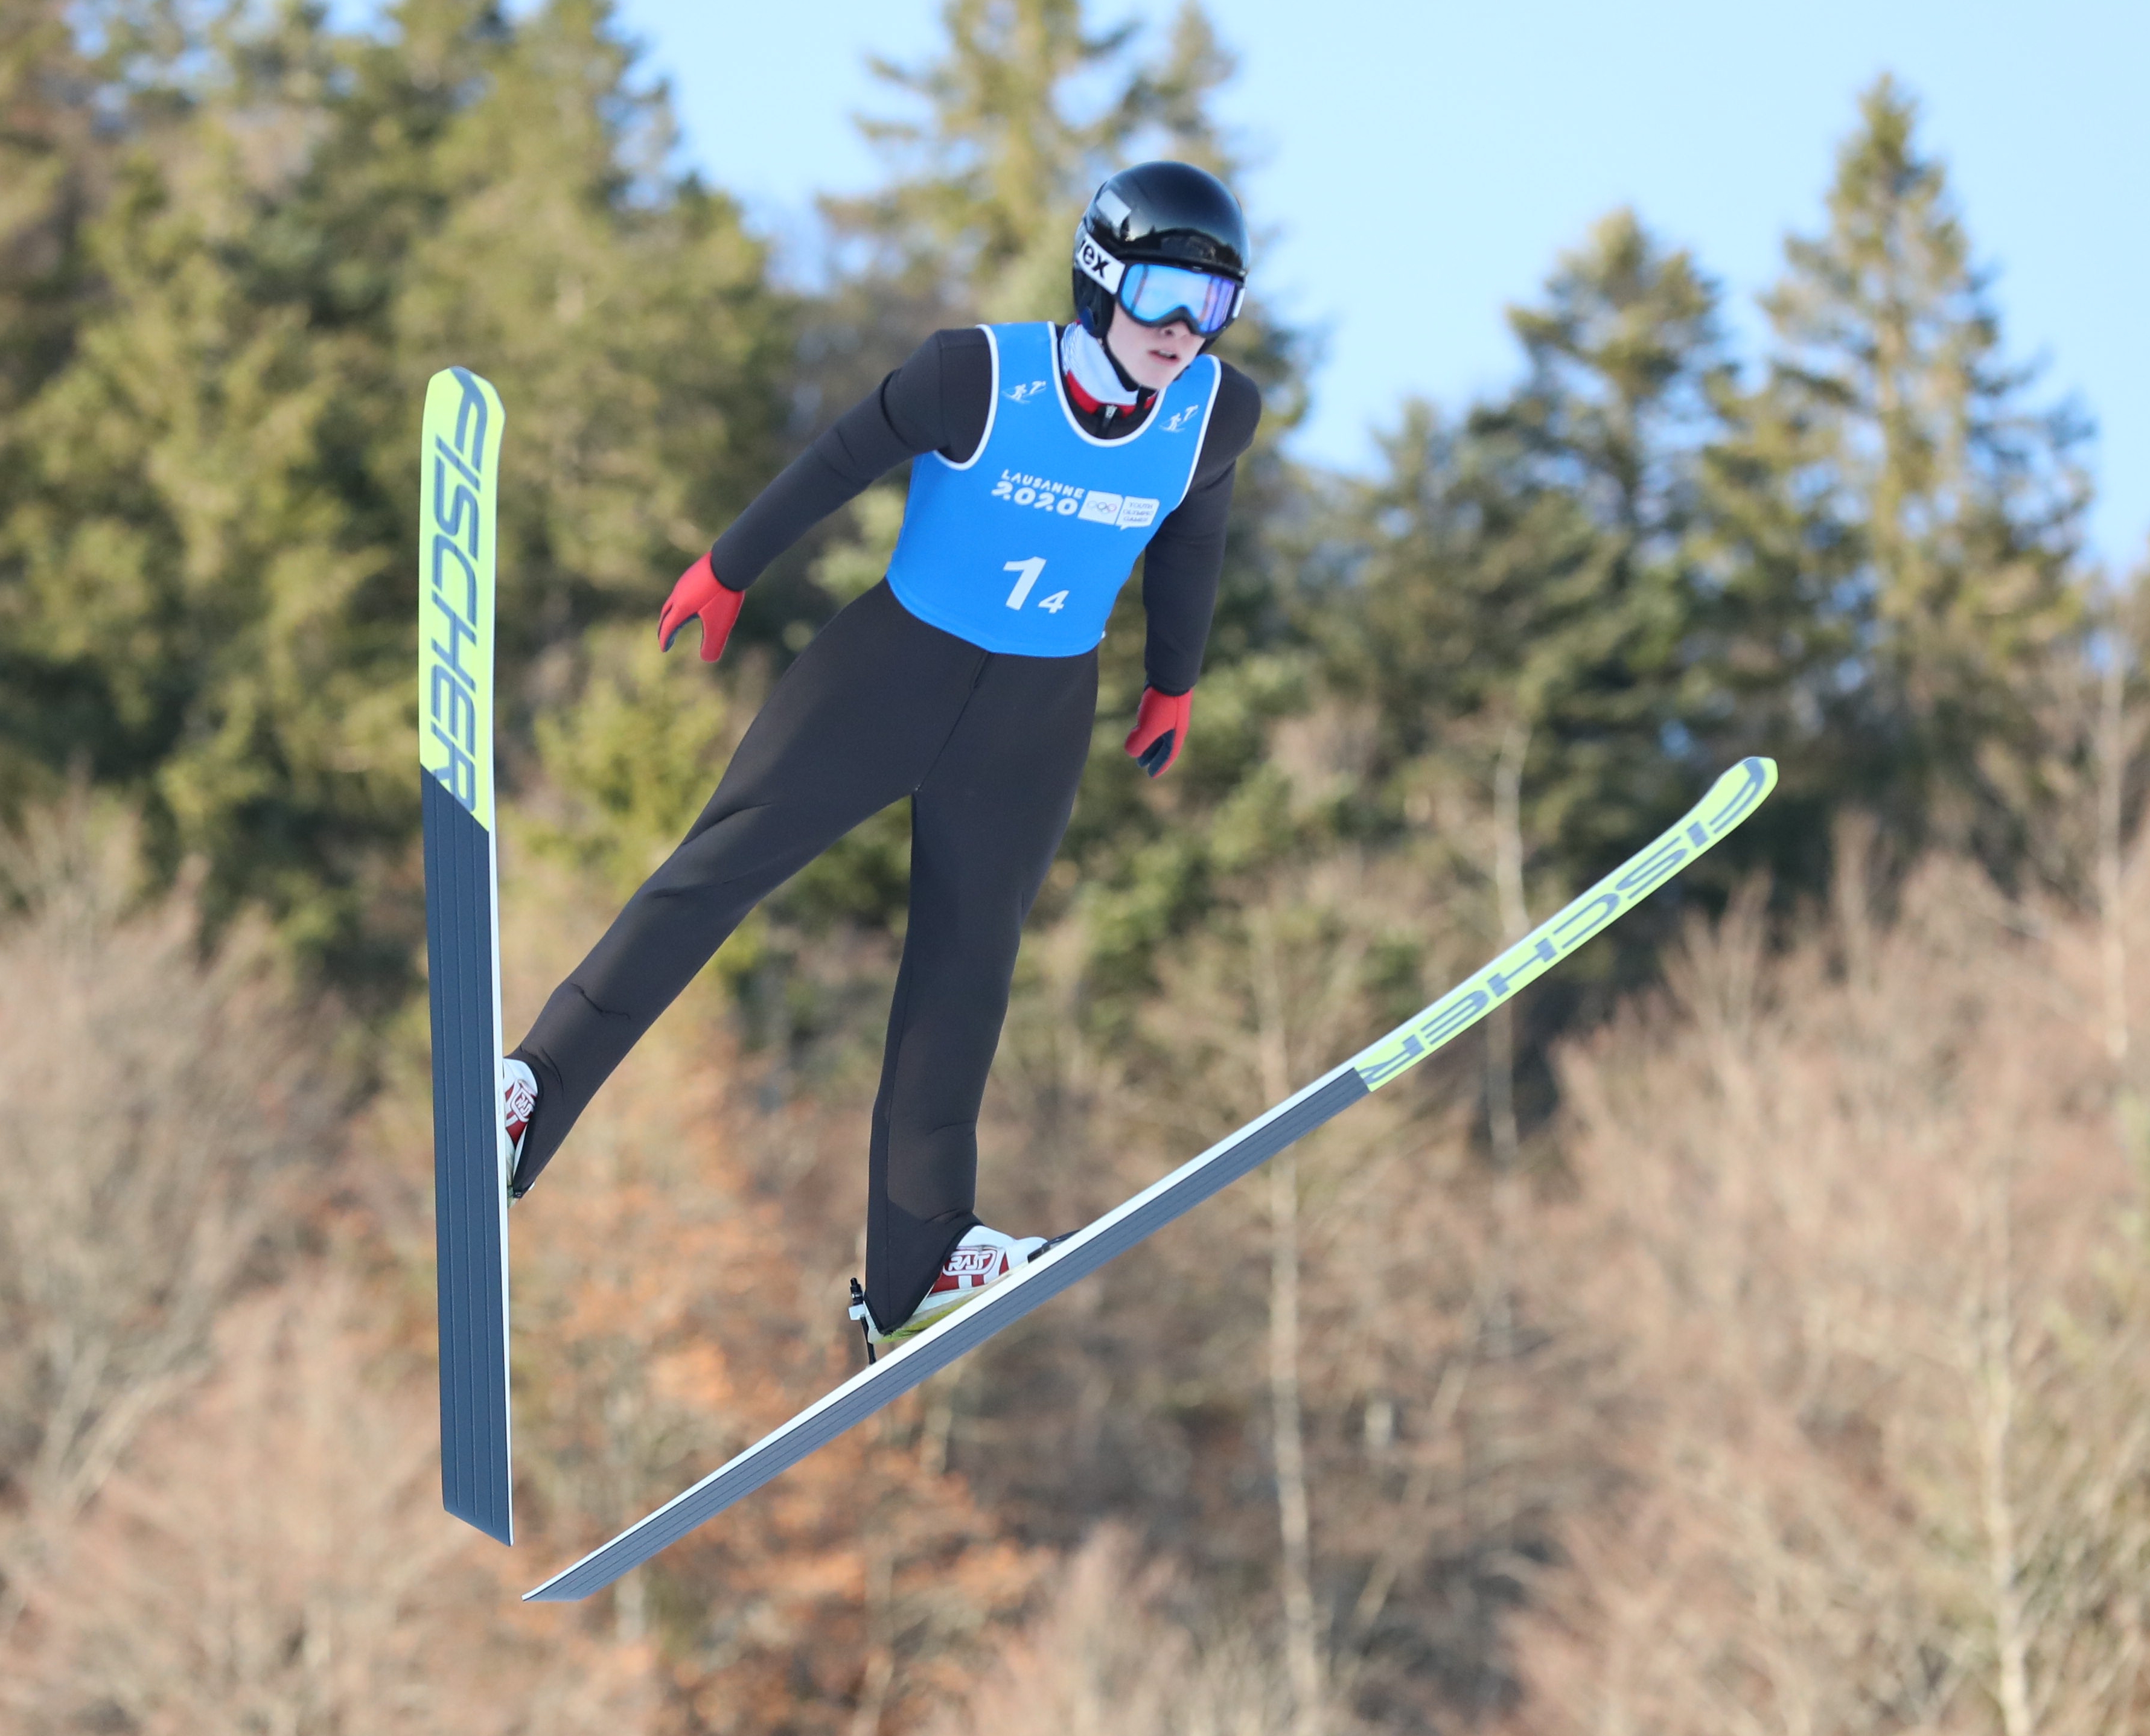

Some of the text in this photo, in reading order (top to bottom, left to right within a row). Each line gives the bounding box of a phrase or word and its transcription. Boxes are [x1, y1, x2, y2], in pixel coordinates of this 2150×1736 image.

[990, 480, 1079, 515] 2020
[1001, 469, 1085, 499] LAUSANNE
[431, 366, 488, 812] FISCHER
[1003, 556, 1070, 614] 1 4
[1357, 756, 1766, 1085] FISCHER
